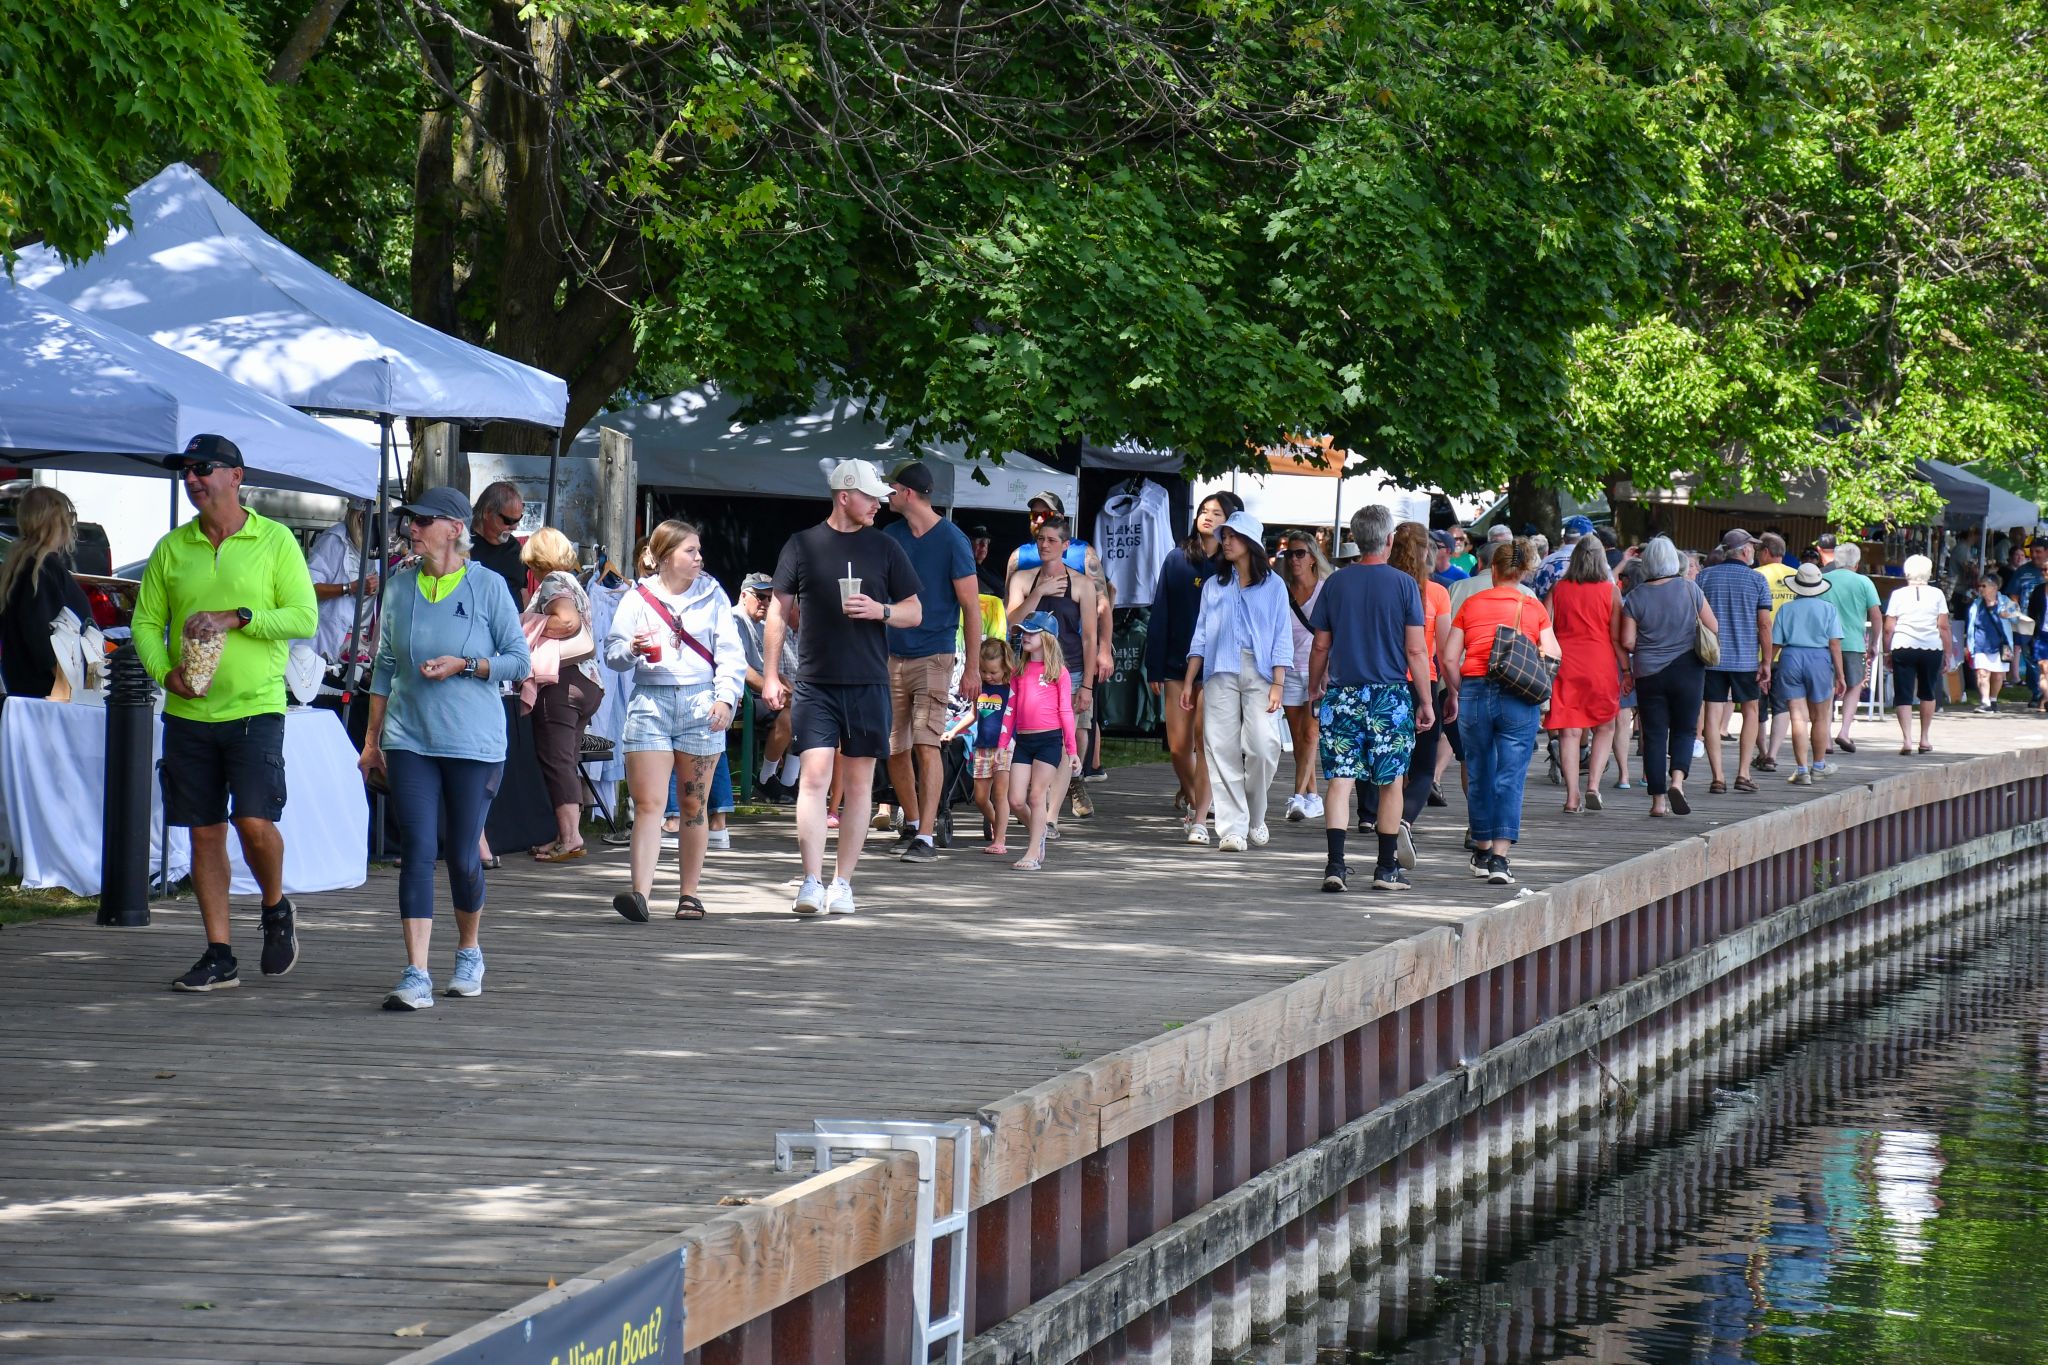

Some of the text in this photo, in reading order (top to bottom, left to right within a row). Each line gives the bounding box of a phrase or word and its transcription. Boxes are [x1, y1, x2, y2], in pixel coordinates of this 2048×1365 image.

[1106, 524, 1142, 535] LAKE
[1107, 536, 1141, 547] RAGS
[1107, 549, 1129, 559] CO.
[1114, 647, 1139, 658] AKE
[1115, 660, 1139, 671] AGS
[620, 1306, 662, 1365] Boat?
